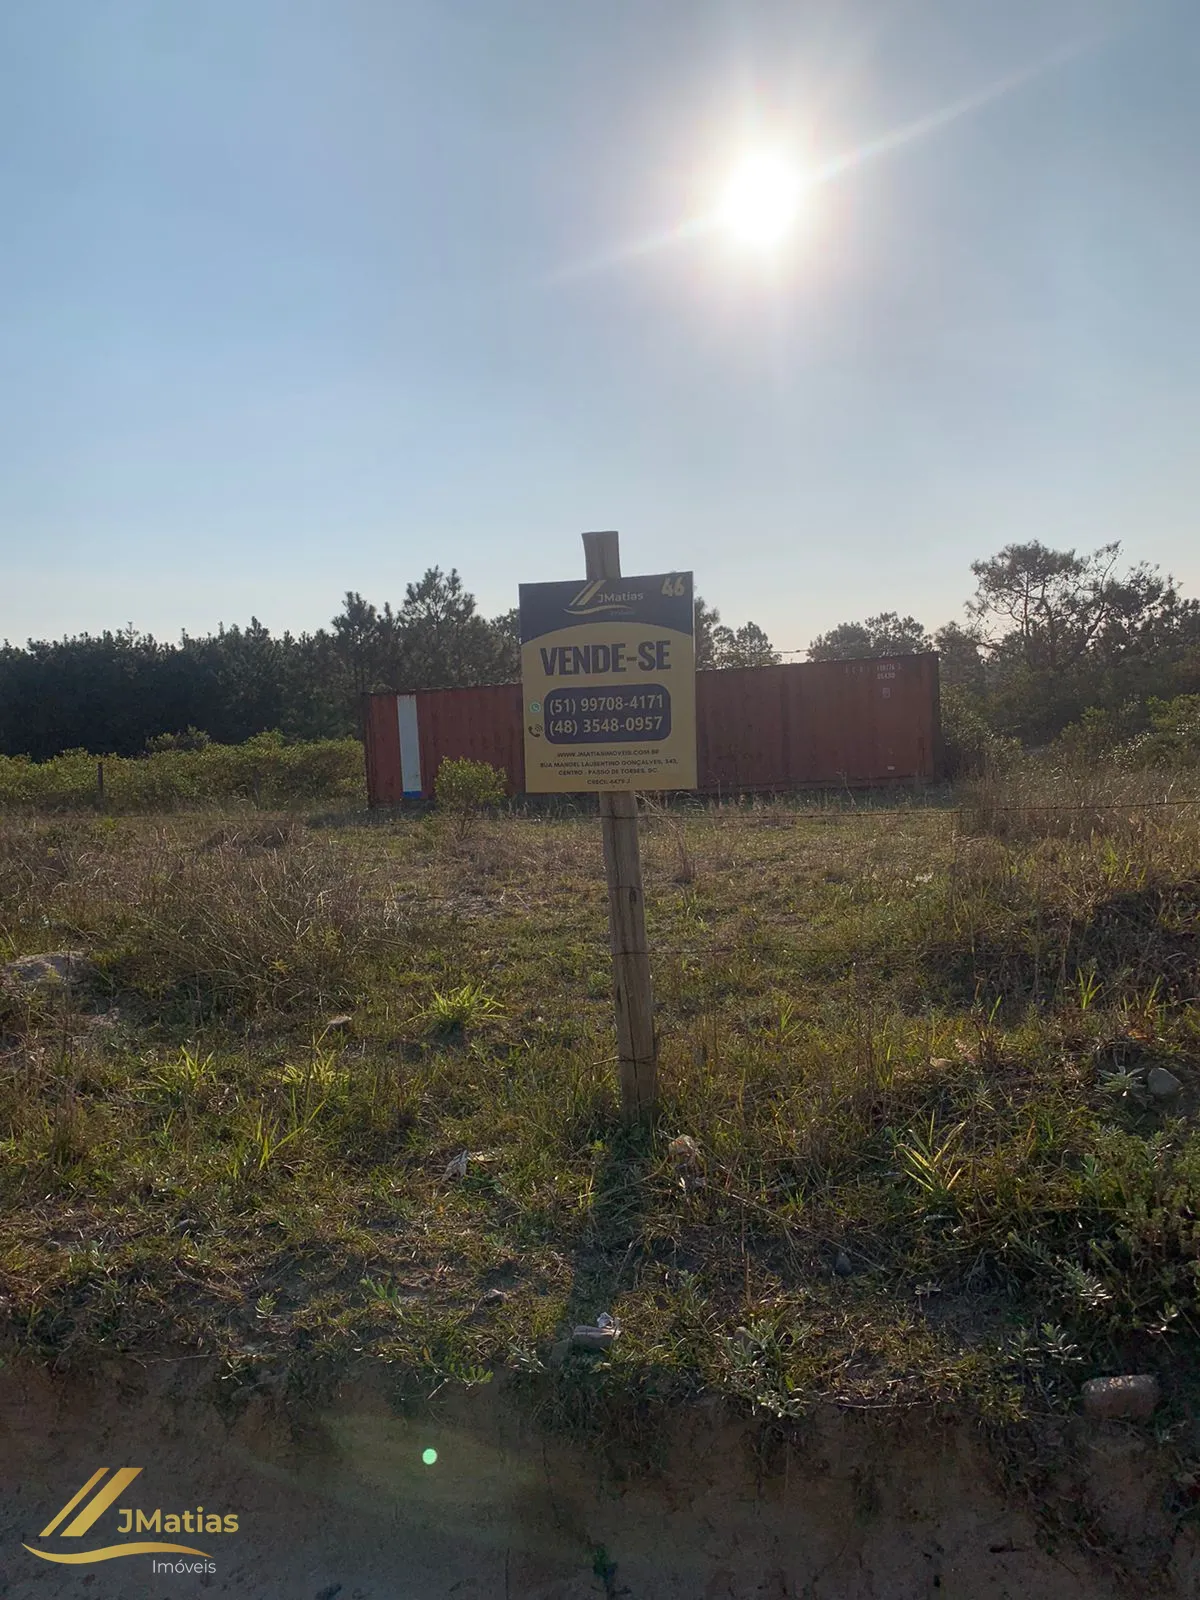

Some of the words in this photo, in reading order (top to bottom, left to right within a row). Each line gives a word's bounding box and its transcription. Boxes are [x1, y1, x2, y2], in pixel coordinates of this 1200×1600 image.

[598, 591, 644, 603] JMatias
[661, 576, 685, 597] 46
[540, 640, 672, 676] VENDE-SE
[550, 699, 576, 715] (51)
[581, 694, 663, 712] 99708-4171
[550, 719, 578, 736] (48)
[583, 716, 663, 733] 3548-0957
